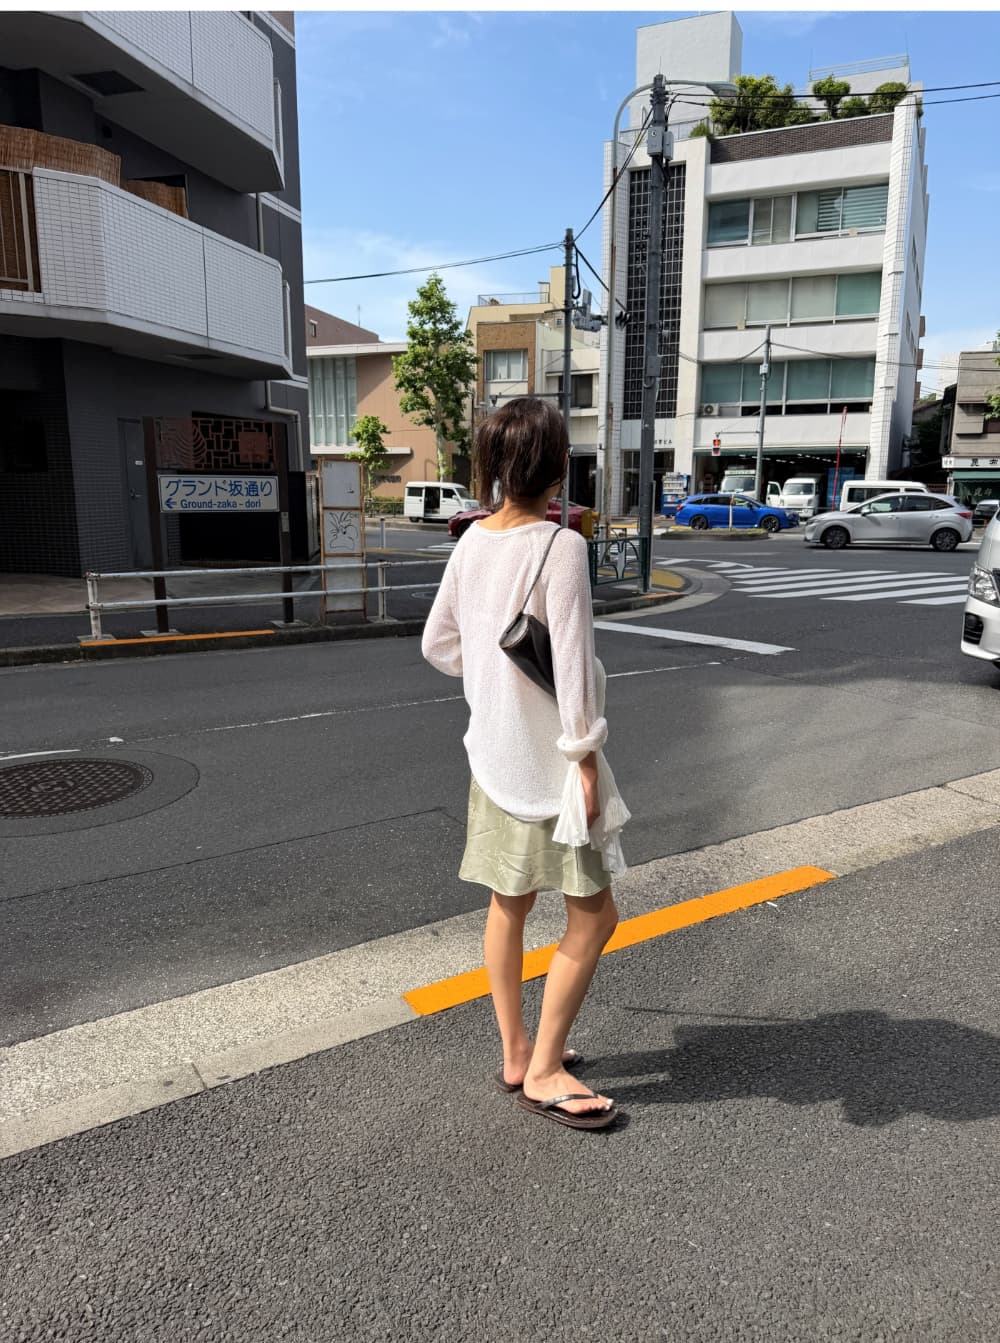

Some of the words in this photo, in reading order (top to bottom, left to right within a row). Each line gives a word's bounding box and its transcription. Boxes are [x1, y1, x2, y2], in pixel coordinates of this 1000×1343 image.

[166, 479, 273, 497] グランド坂通り
